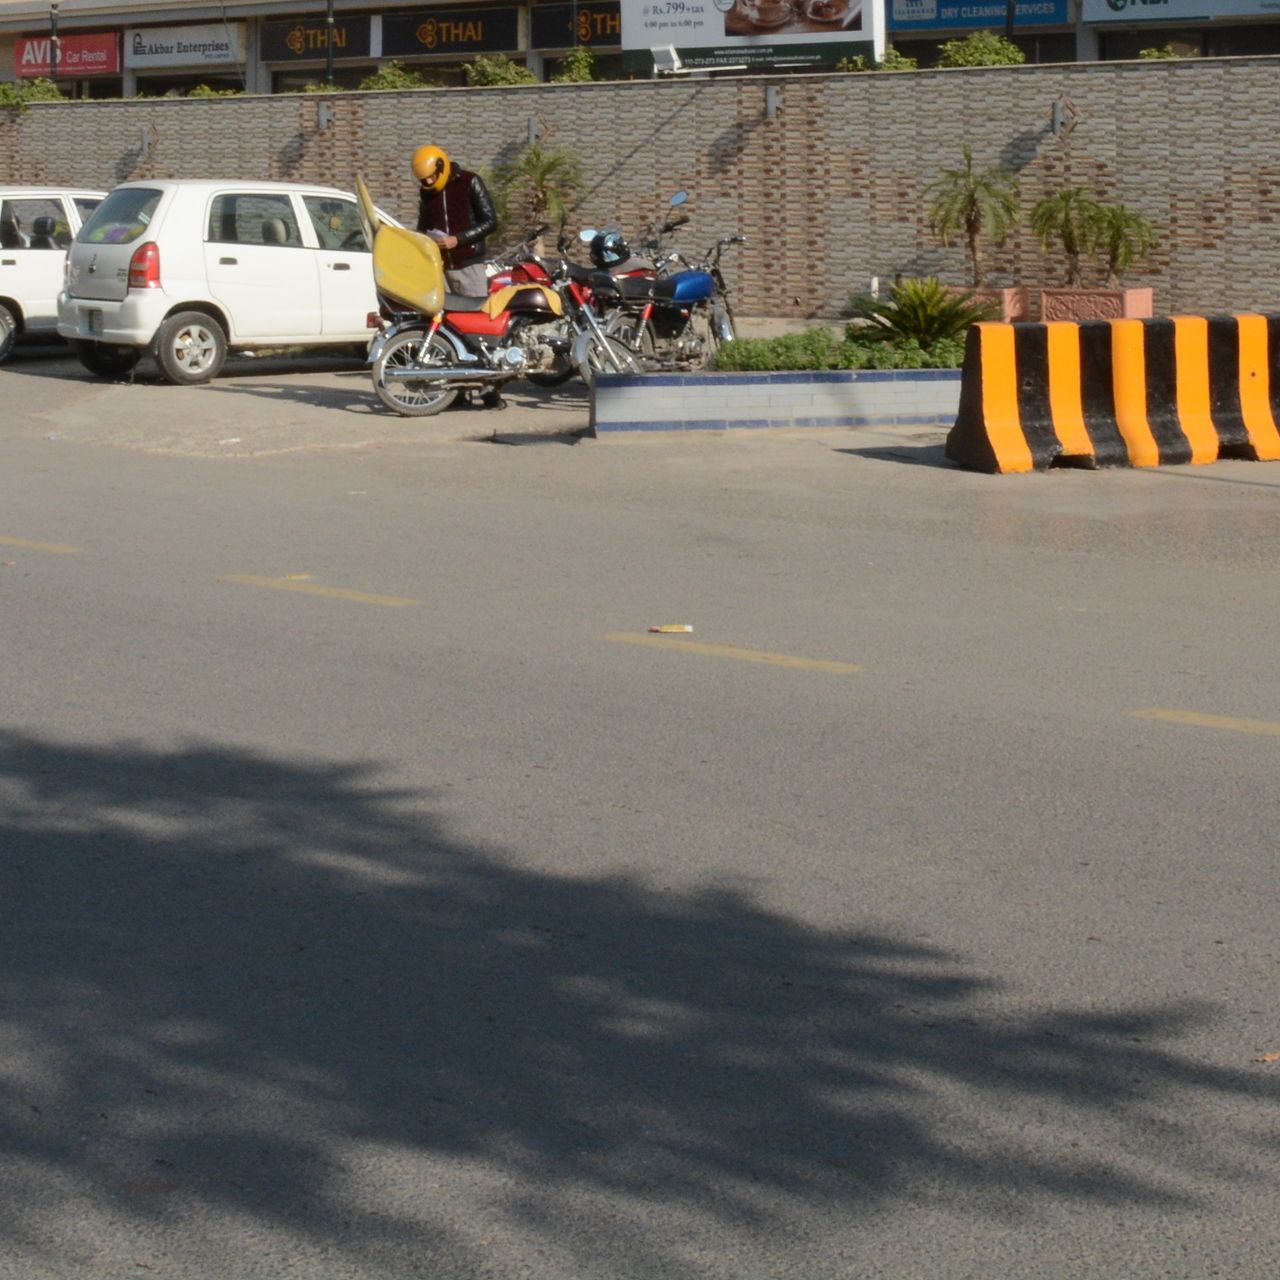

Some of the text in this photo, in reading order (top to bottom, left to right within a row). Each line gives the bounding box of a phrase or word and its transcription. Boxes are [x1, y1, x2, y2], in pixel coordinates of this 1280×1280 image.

[941, 2, 1056, 19] DRY CLEANING ERVICES
[306, 28, 347, 48] THAI
[440, 21, 483, 41] THAI
[66, 49, 107, 62] Car Rental
[148, 40, 230, 56] Akbar Enterprises
